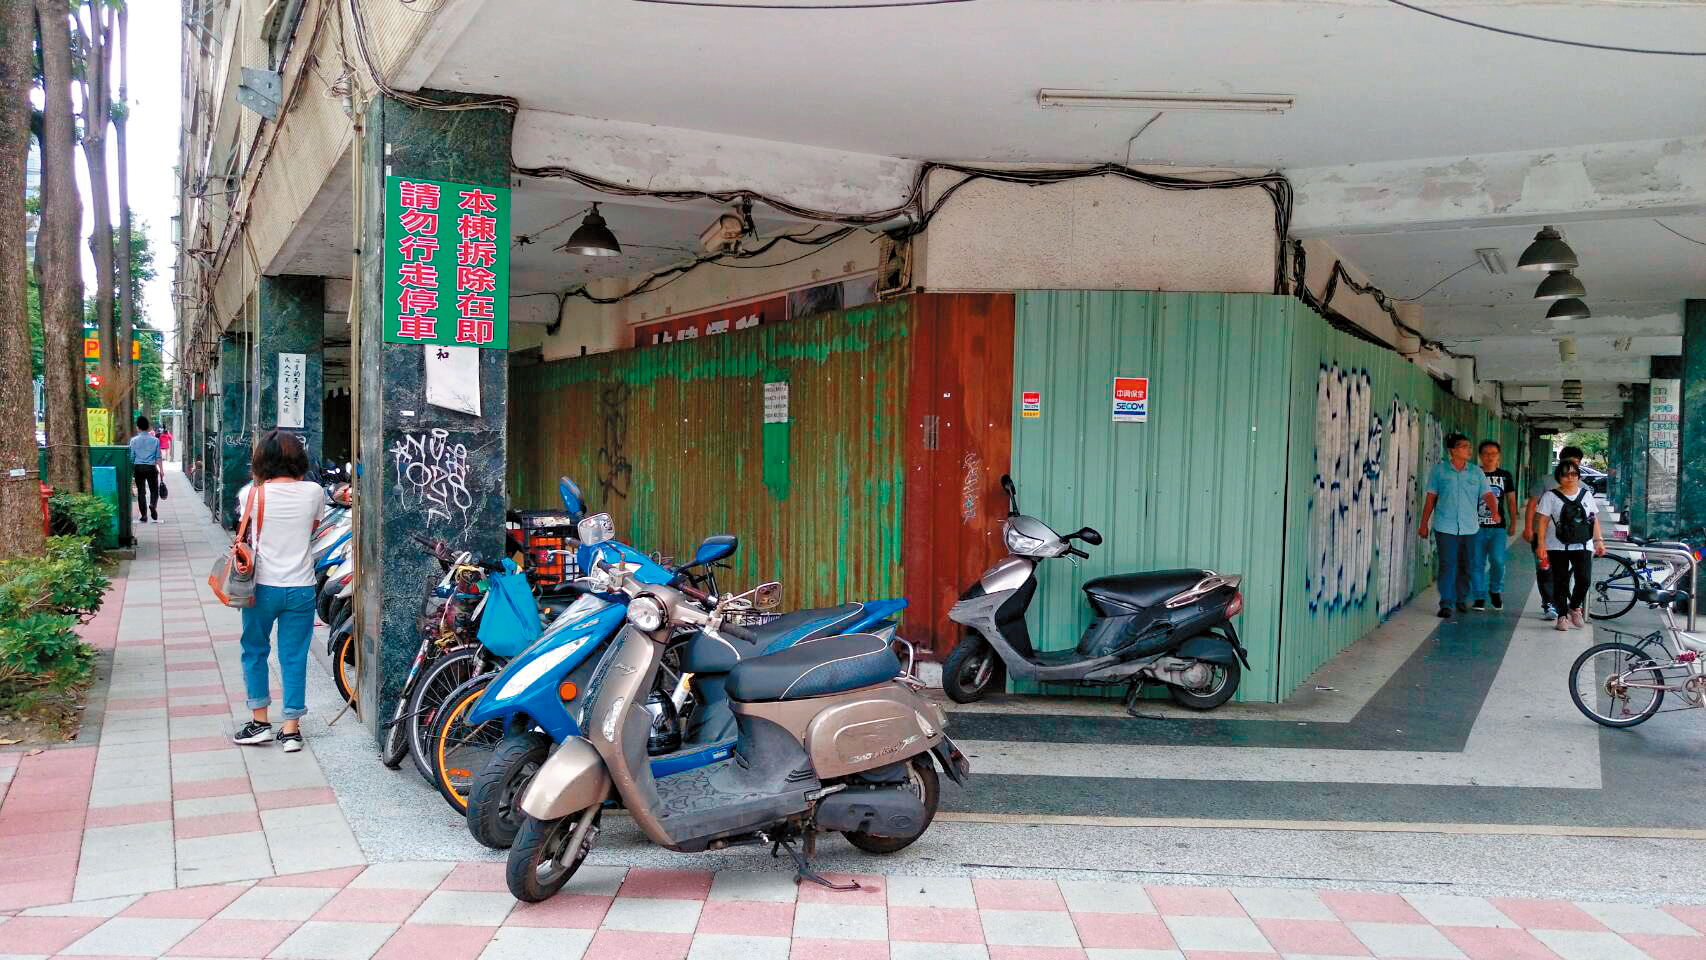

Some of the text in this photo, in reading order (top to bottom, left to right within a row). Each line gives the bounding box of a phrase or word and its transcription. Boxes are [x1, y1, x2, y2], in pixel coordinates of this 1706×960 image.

[397, 182, 440, 340] 請勿行走停車
[455, 187, 497, 345] 本棟拆除在即
[1116, 402, 1144, 410] SECOM
